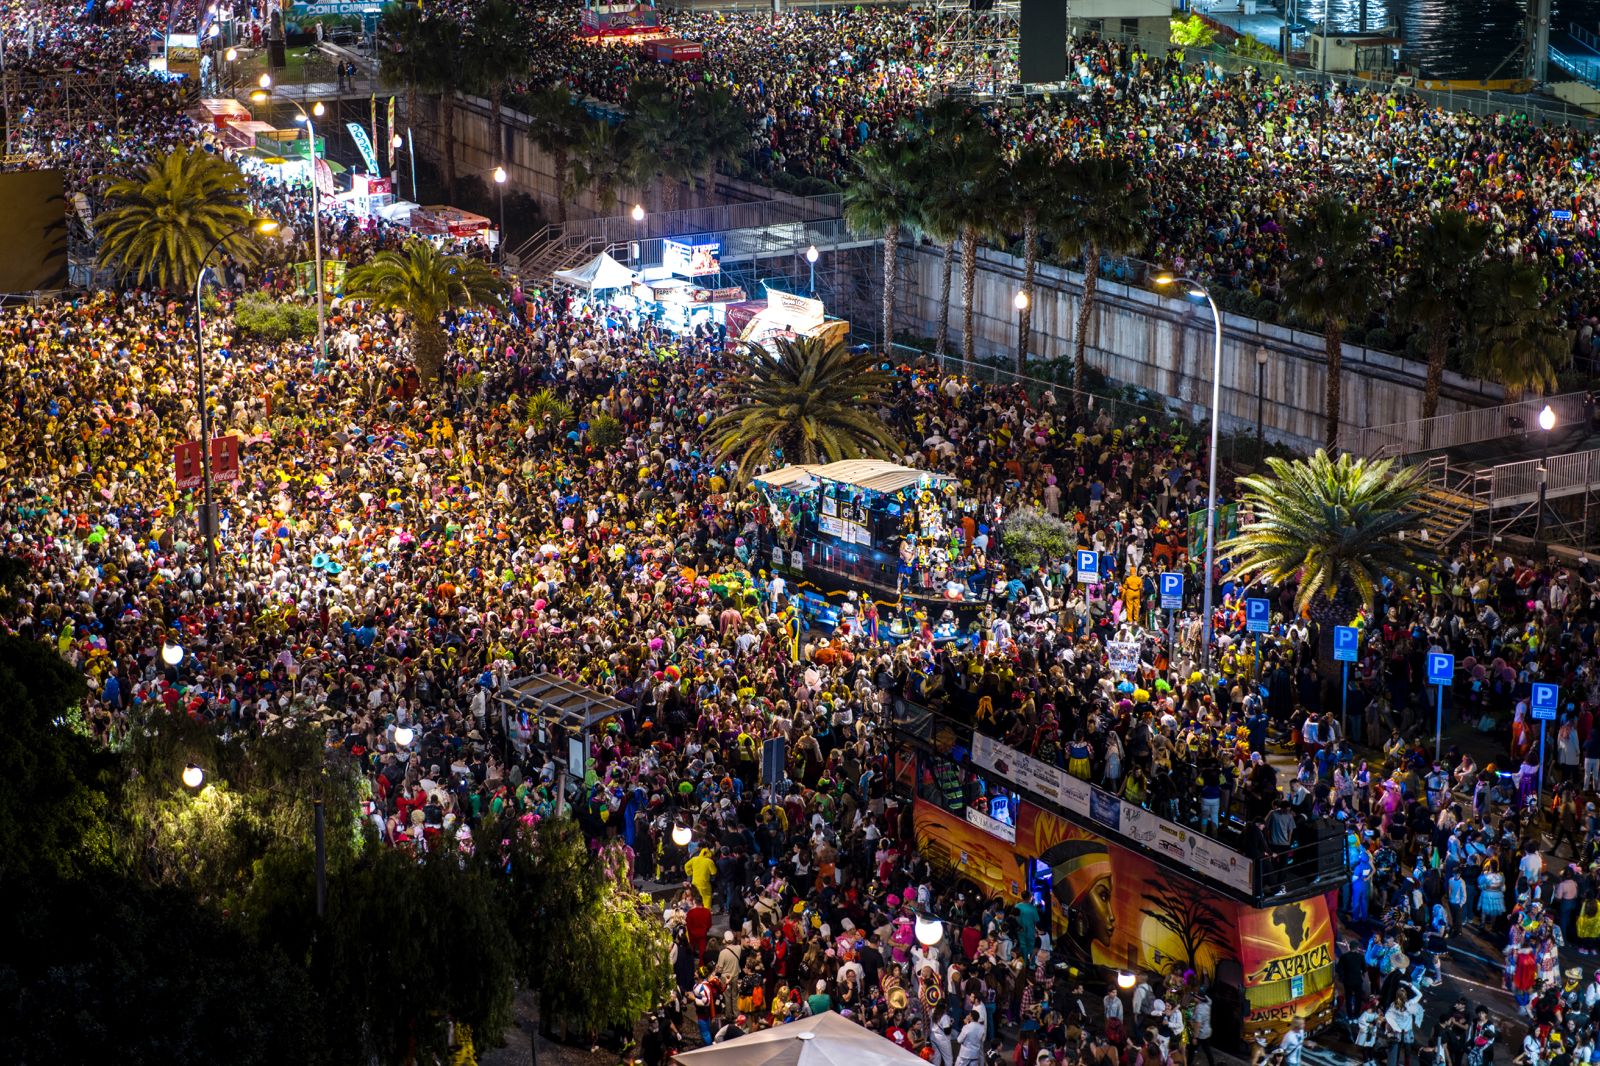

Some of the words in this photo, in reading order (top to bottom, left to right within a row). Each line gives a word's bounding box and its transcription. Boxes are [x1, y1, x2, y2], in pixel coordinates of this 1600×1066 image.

[307, 5, 330, 14] CON
[177, 475, 201, 488] Coca-Cola
[213, 470, 238, 482] Coca-Cola
[1081, 553, 1094, 570] P
[1165, 576, 1179, 592] P
[1251, 601, 1265, 618] P
[1339, 629, 1353, 646] P
[1434, 657, 1449, 674] P
[1537, 687, 1552, 704] P
[1262, 944, 1332, 982] AFRICA
[1250, 1003, 1297, 1021] LAUREN
